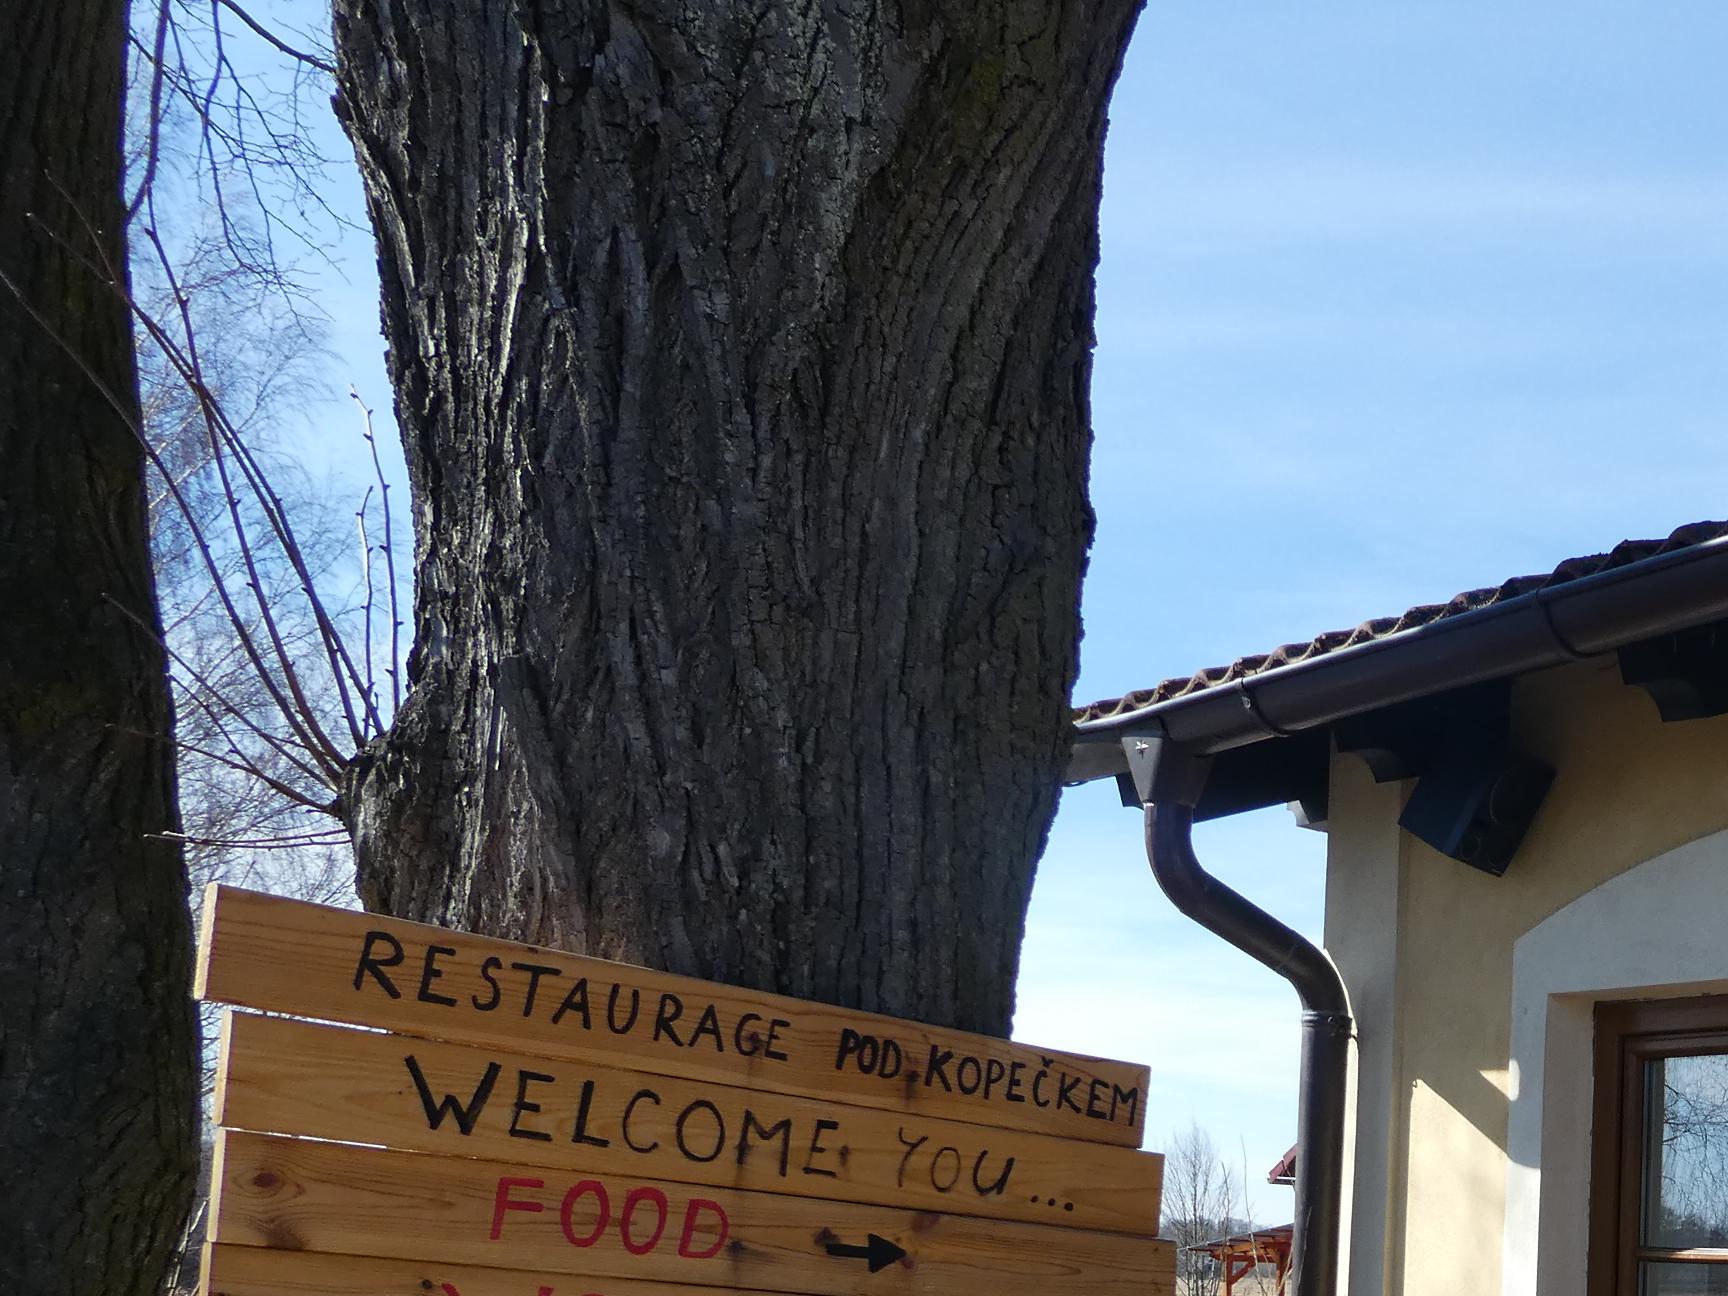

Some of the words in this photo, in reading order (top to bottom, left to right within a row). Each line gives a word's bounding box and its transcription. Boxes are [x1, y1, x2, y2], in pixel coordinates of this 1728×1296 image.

[352, 931, 790, 1061] RESTAURAGE
[835, 1028, 903, 1080] POD
[924, 1044, 1139, 1127] KOPEČKEM
[404, 1055, 840, 1178] WELCOME
[489, 1176, 729, 1259] FOOD
